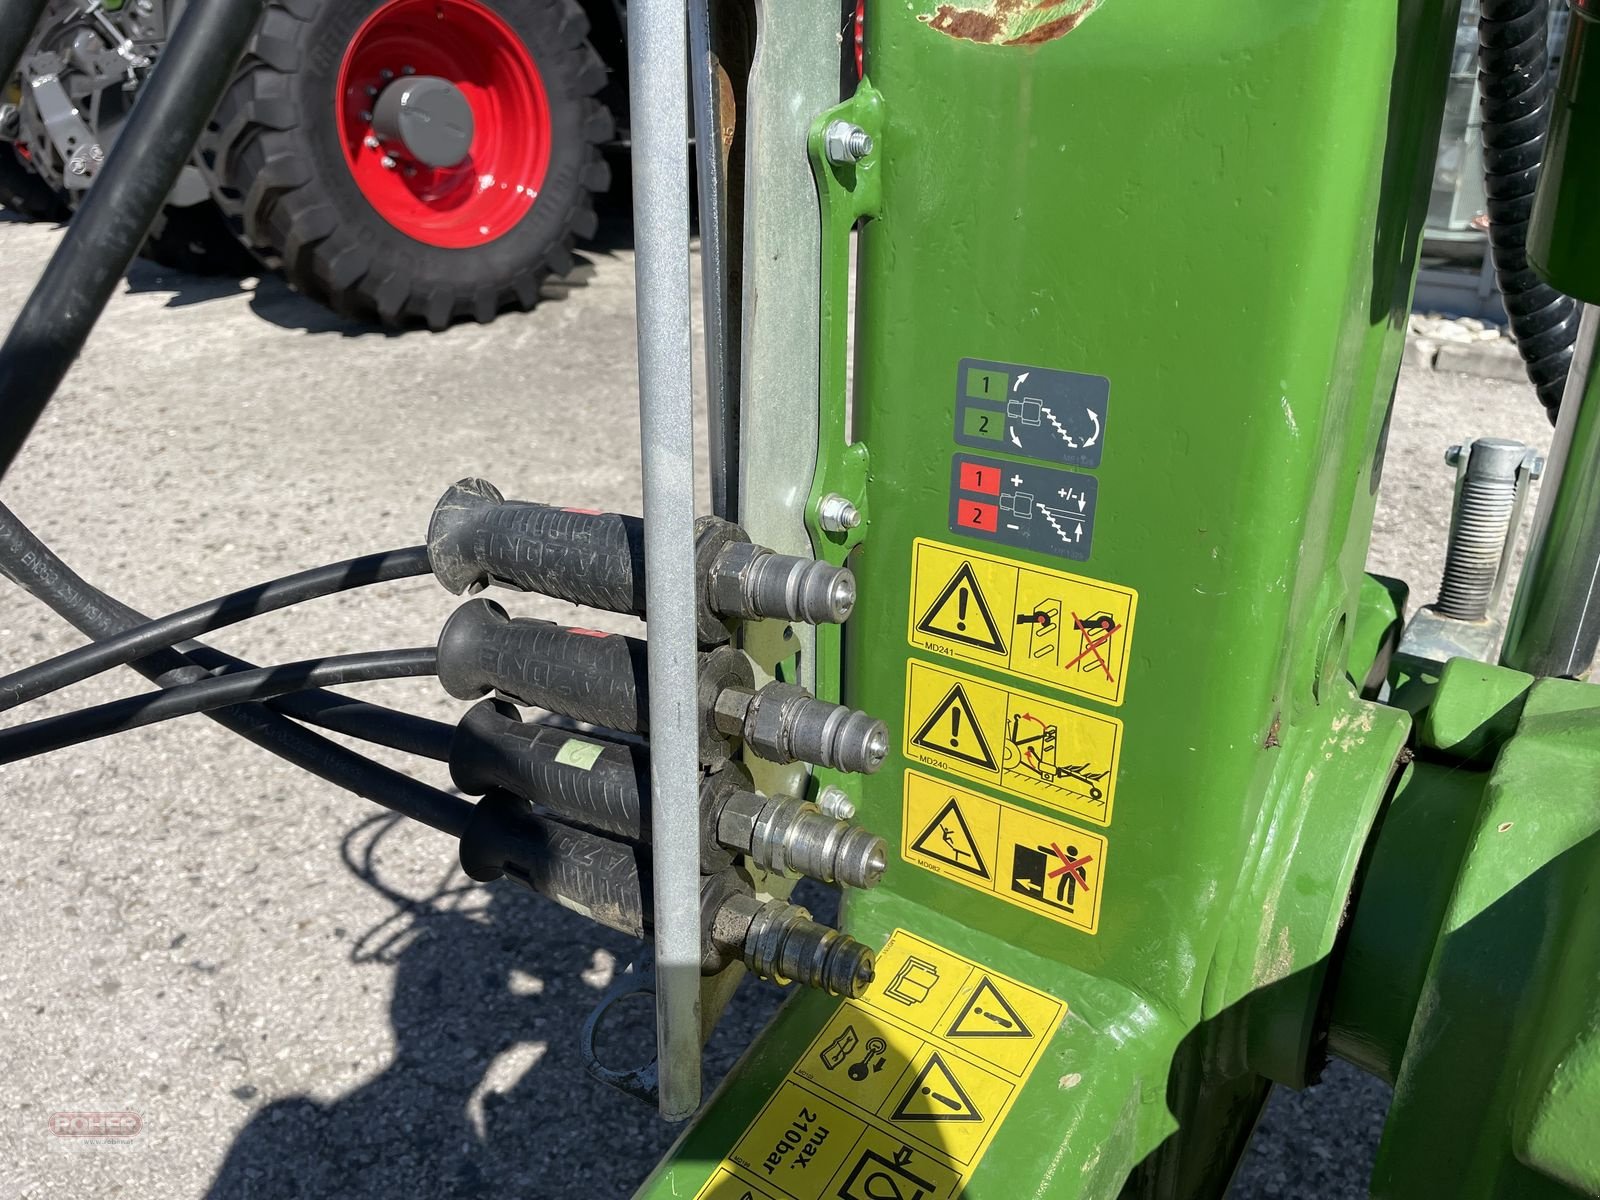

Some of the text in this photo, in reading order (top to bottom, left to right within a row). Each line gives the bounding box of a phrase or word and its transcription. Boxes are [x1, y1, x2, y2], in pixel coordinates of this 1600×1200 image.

[982, 376, 990, 393] 1
[978, 415, 989, 433] 2
[975, 470, 983, 487] 1
[972, 508, 983, 524] 2
[924, 641, 954, 657] MD241
[919, 754, 948, 770] MD240
[763, 1107, 817, 1175] 210bar
[790, 1126, 830, 1169] max.
